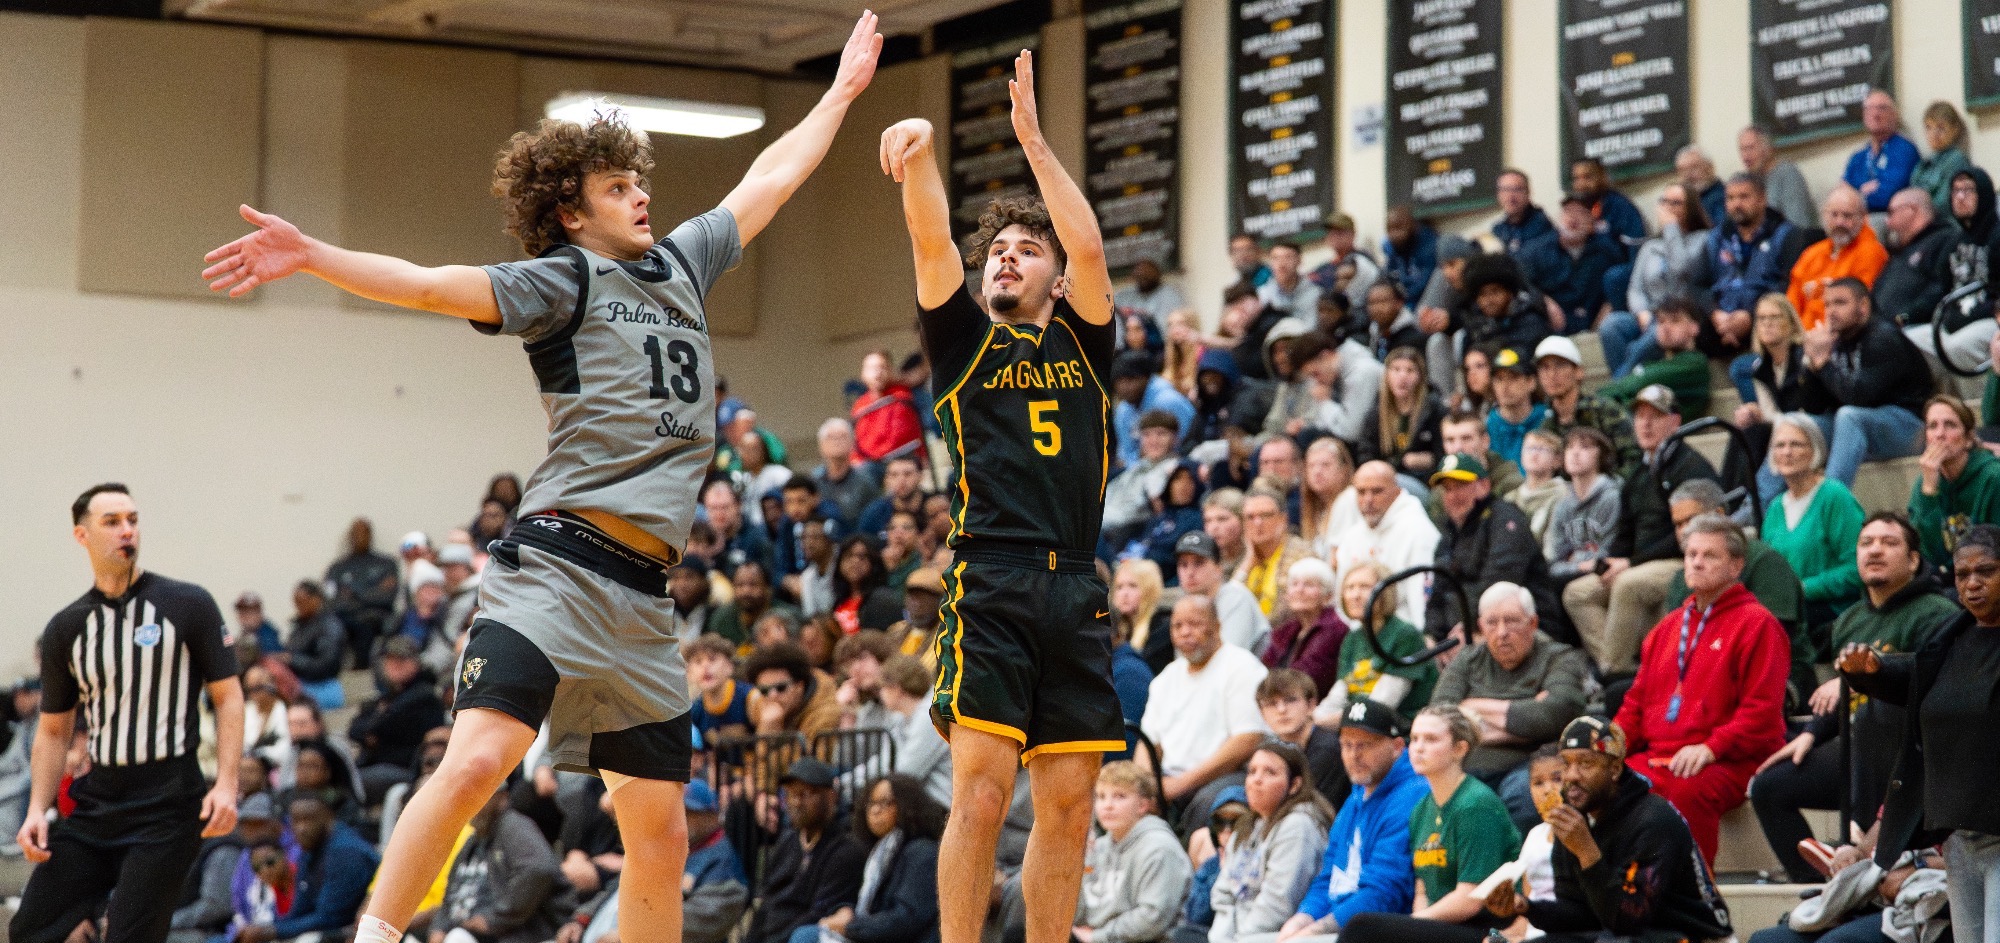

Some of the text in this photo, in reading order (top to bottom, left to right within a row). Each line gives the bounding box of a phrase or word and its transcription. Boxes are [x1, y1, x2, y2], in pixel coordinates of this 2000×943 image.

[606, 301, 661, 325] Palm
[643, 334, 702, 404] 13
[983, 360, 1084, 390] JAGUARS
[655, 411, 701, 442] State
[1028, 400, 1062, 457] 5
